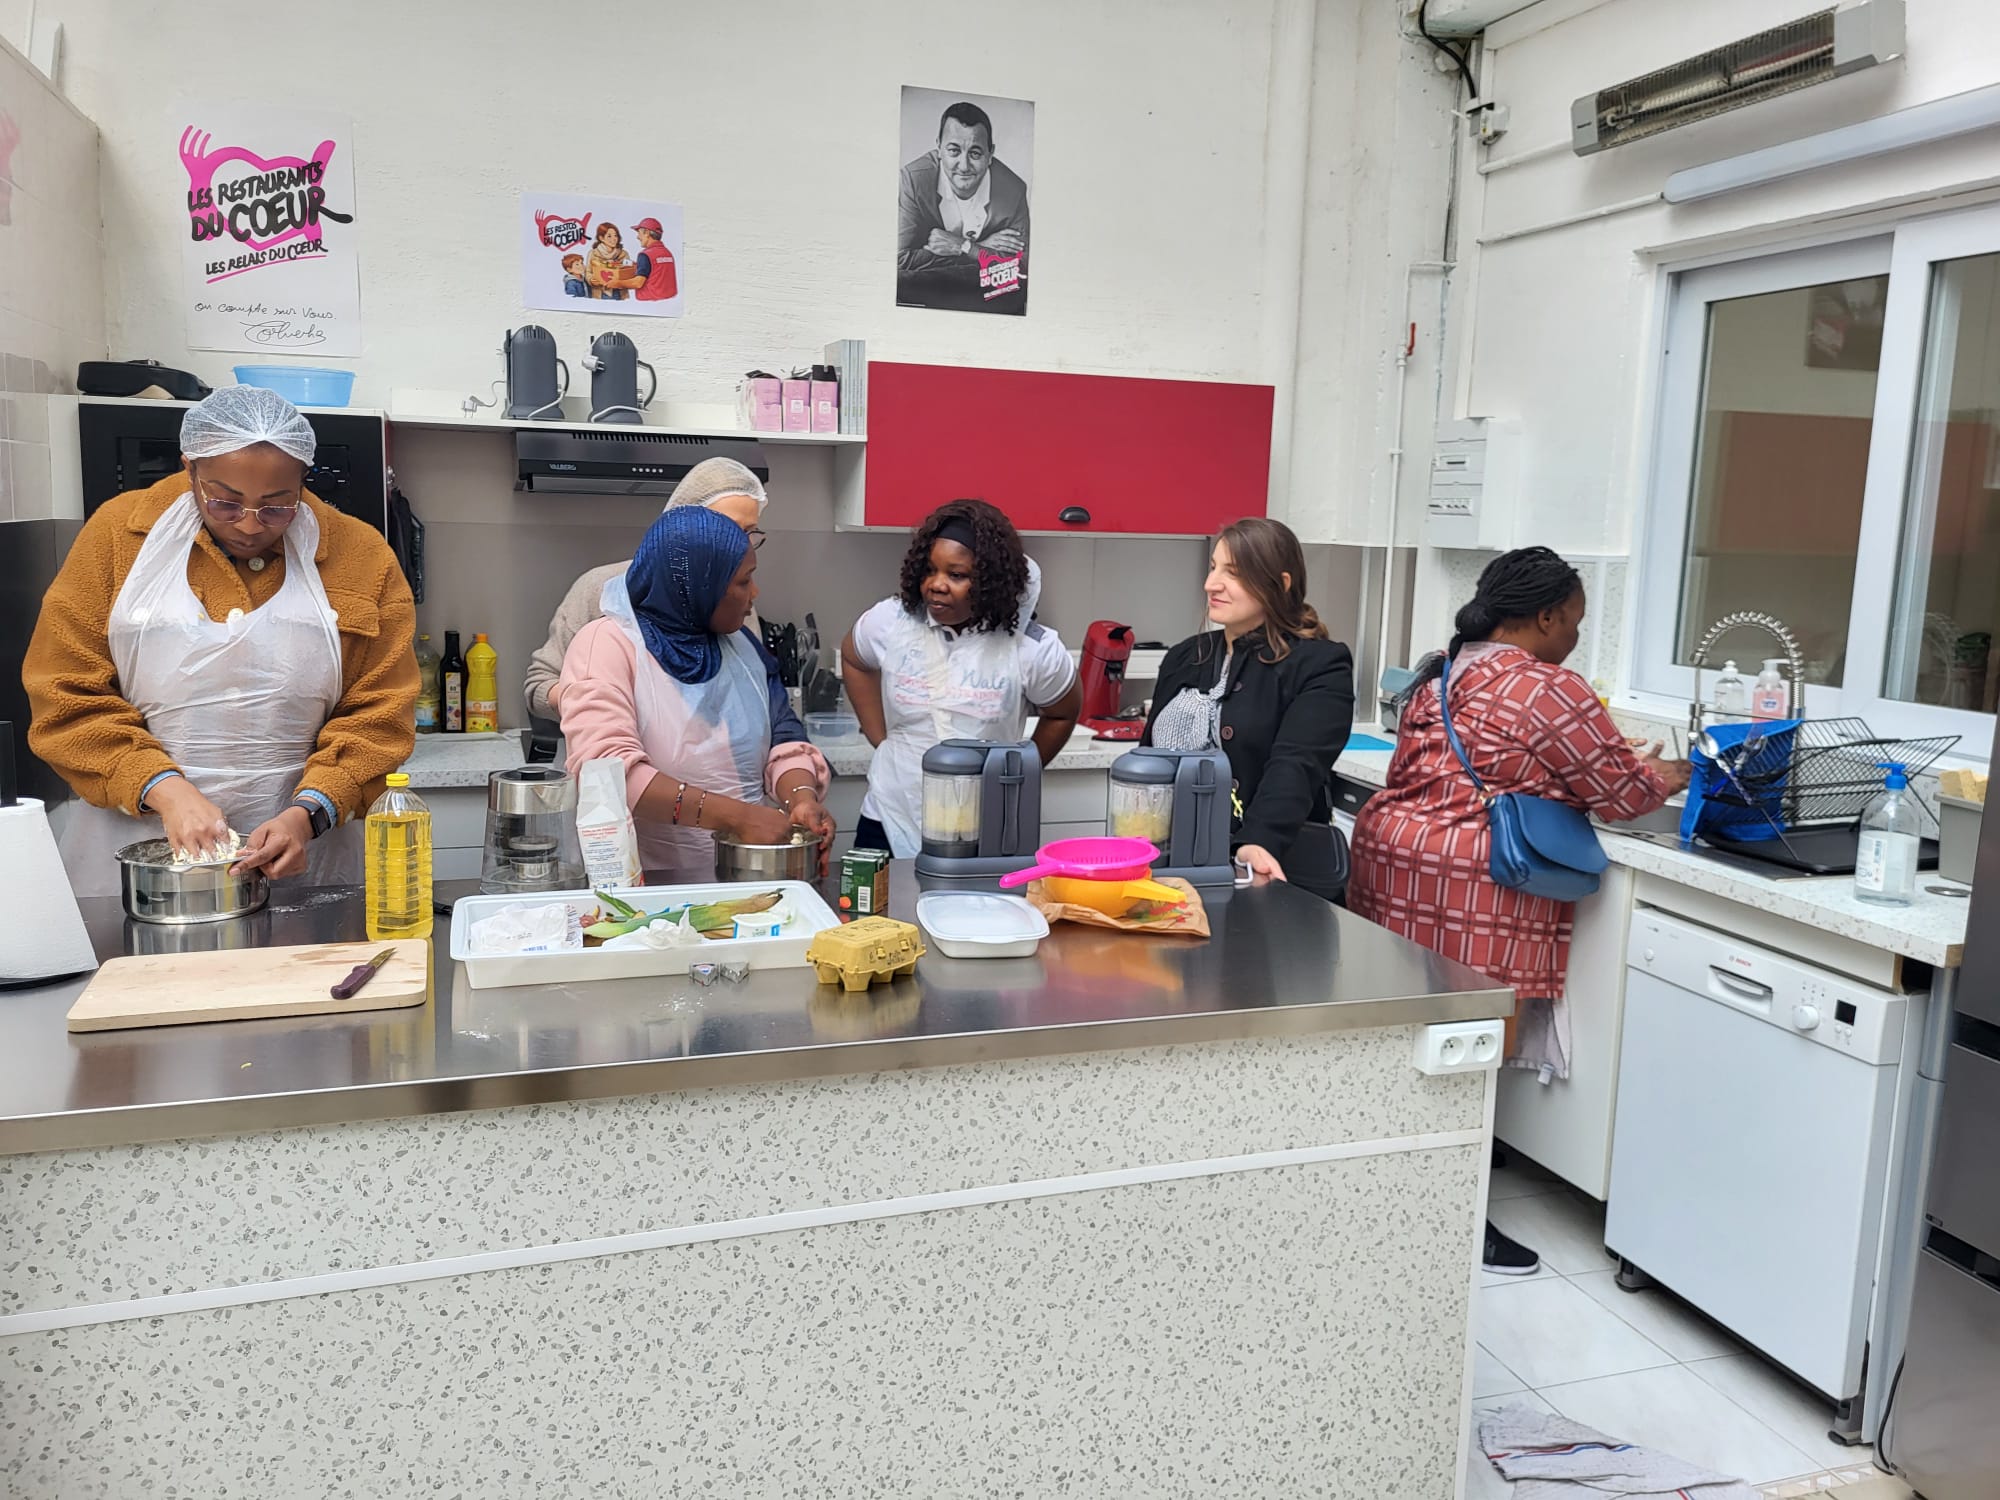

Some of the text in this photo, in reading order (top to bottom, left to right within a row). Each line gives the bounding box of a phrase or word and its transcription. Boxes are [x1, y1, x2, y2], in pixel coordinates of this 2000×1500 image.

[188, 161, 323, 212] LES RESTAURANTS
[191, 211, 224, 241] DU
[544, 226, 554, 236] LES
[544, 236, 553, 246] DU
[206, 261, 225, 275] LES
[227, 251, 267, 271] RELAIS
[269, 247, 285, 261] DU
[273, 307, 297, 315] sur
